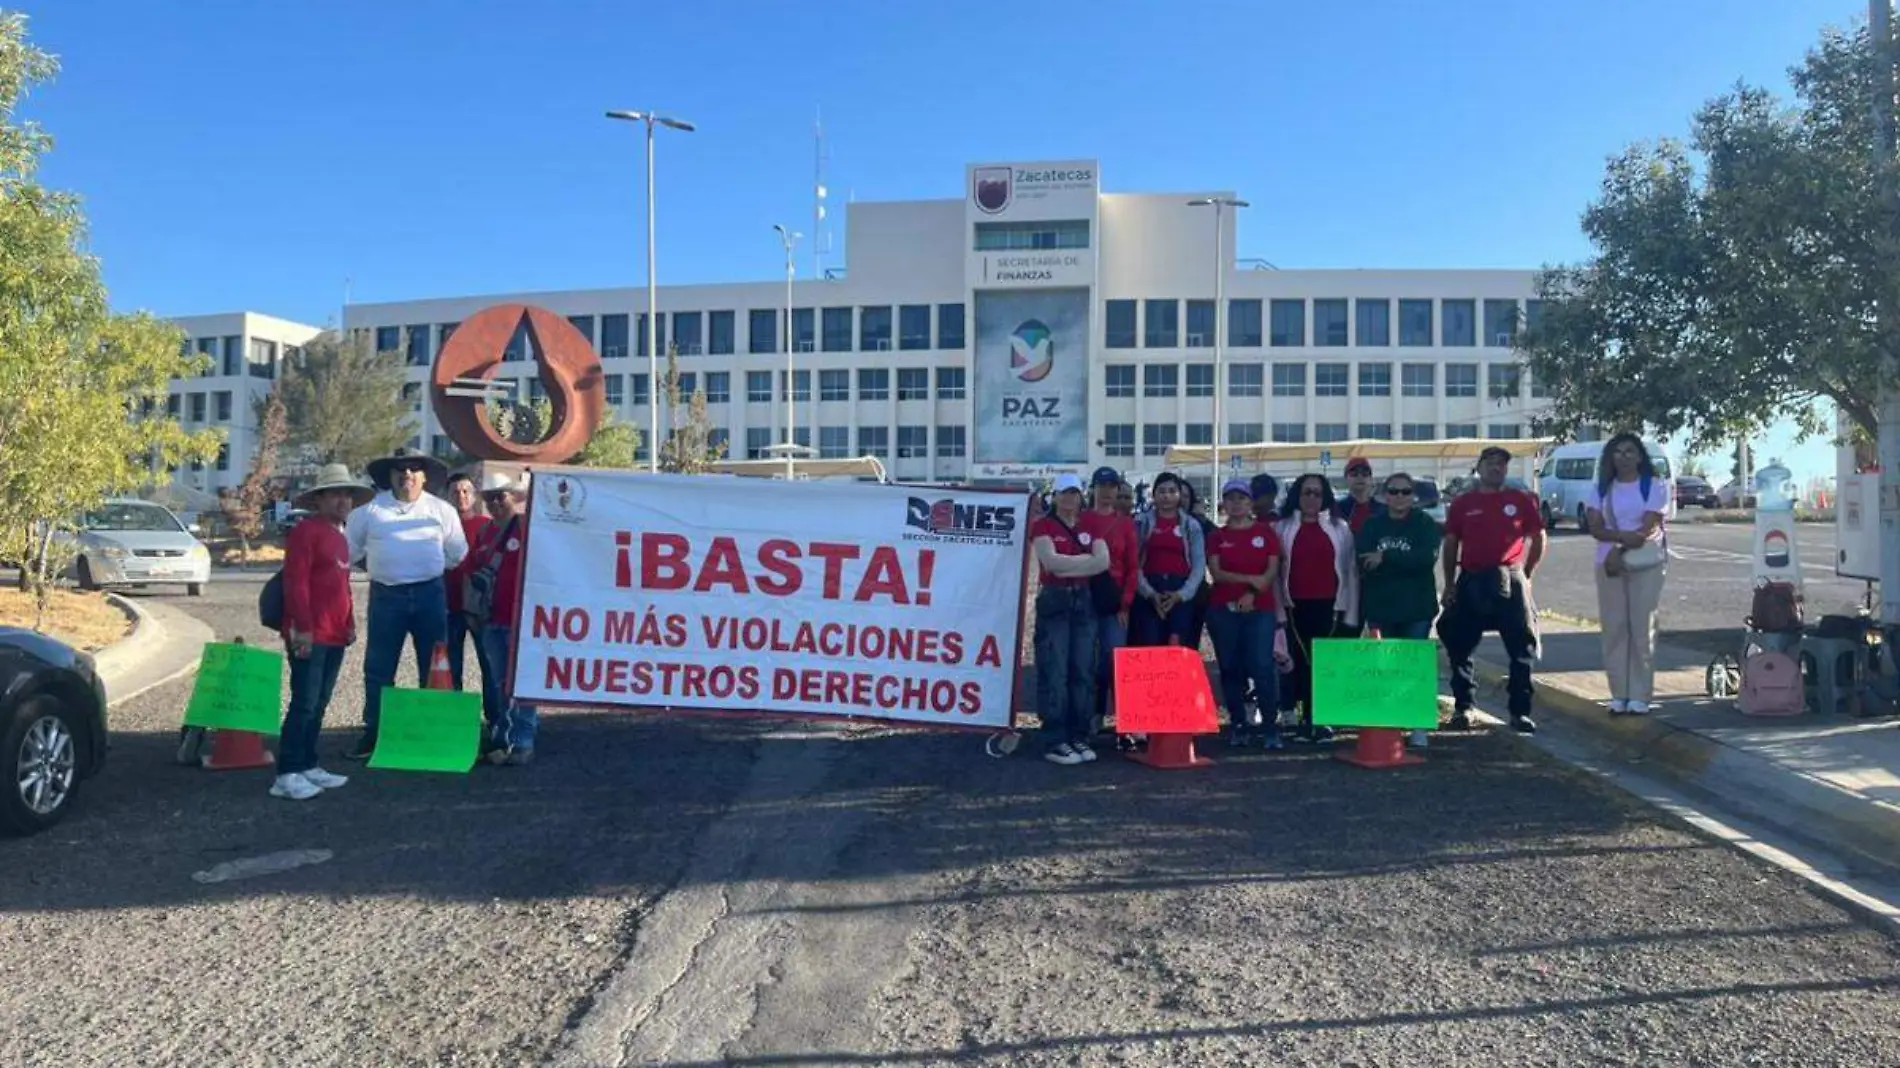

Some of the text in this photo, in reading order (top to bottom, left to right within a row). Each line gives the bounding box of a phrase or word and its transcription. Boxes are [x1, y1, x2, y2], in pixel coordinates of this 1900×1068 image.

[1016, 169, 1091, 182] Zacatecas
[1064, 255, 1080, 266] DE
[996, 270, 1053, 280] FINANZAS
[1002, 397, 1060, 418] PAZ
[613, 530, 936, 606] ¡BASTA!
[532, 604, 1003, 668] NO MÁS VIOLACIONES A
[545, 656, 982, 715] NUESTROS DERECHOS
